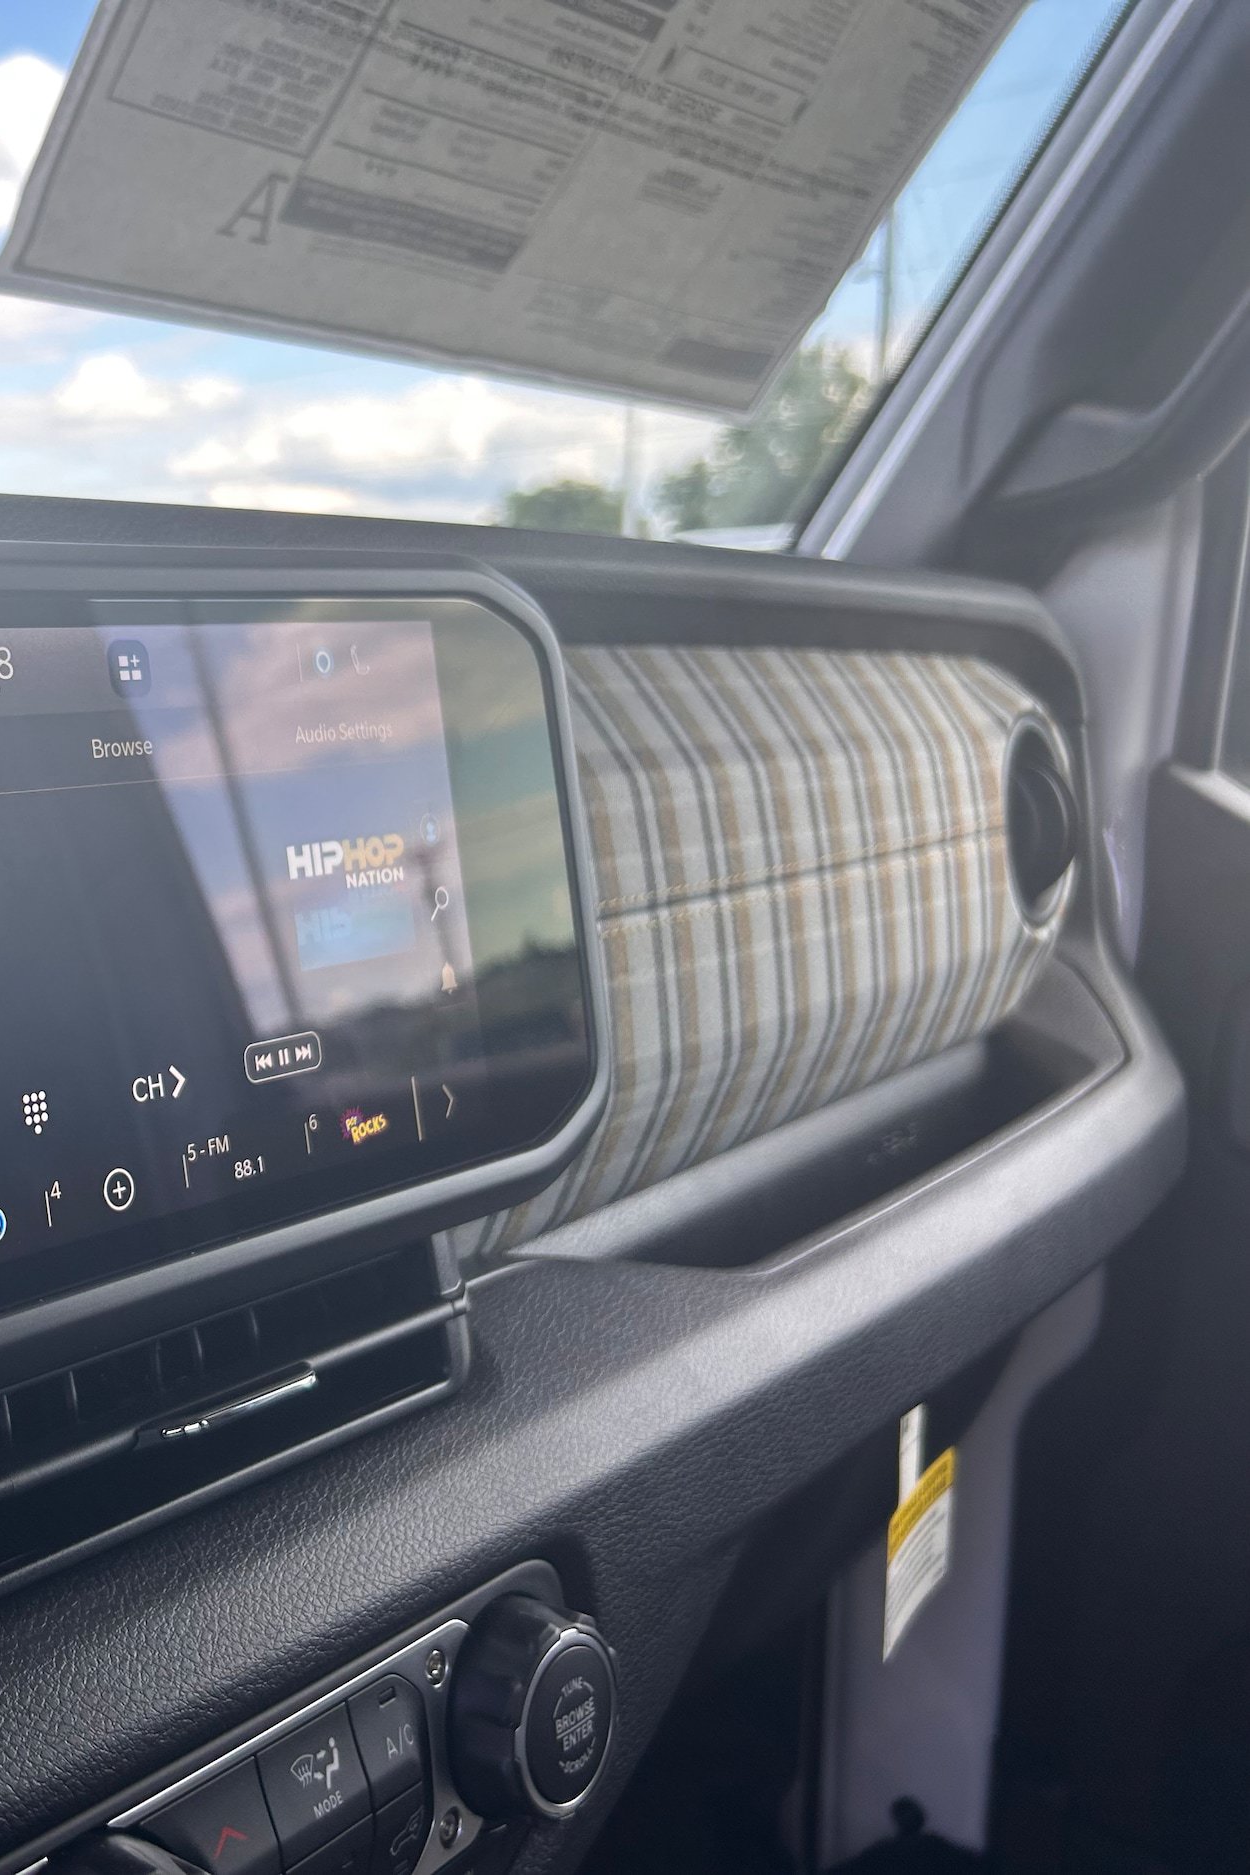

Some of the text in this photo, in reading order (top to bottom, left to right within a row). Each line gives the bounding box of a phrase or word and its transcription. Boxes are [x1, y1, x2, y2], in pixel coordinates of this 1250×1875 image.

[295, 720, 393, 745] Audio Settings
[91, 738, 153, 760] Browse
[345, 866, 404, 889] NATION
[132, 1072, 165, 1104] CH
[309, 1113, 318, 1131] 6
[350, 1113, 387, 1144] ROCKS
[188, 1143, 197, 1162] 5
[207, 1134, 230, 1155] FM
[234, 1156, 265, 1180] 88.1
[50, 1180, 62, 1201] 4
[561, 1676, 583, 1698] TUNE
[555, 1696, 596, 1734] BROWSE
[386, 1723, 415, 1760] A/C
[562, 1719, 593, 1751] ENTER
[313, 1789, 344, 1820] MODE
